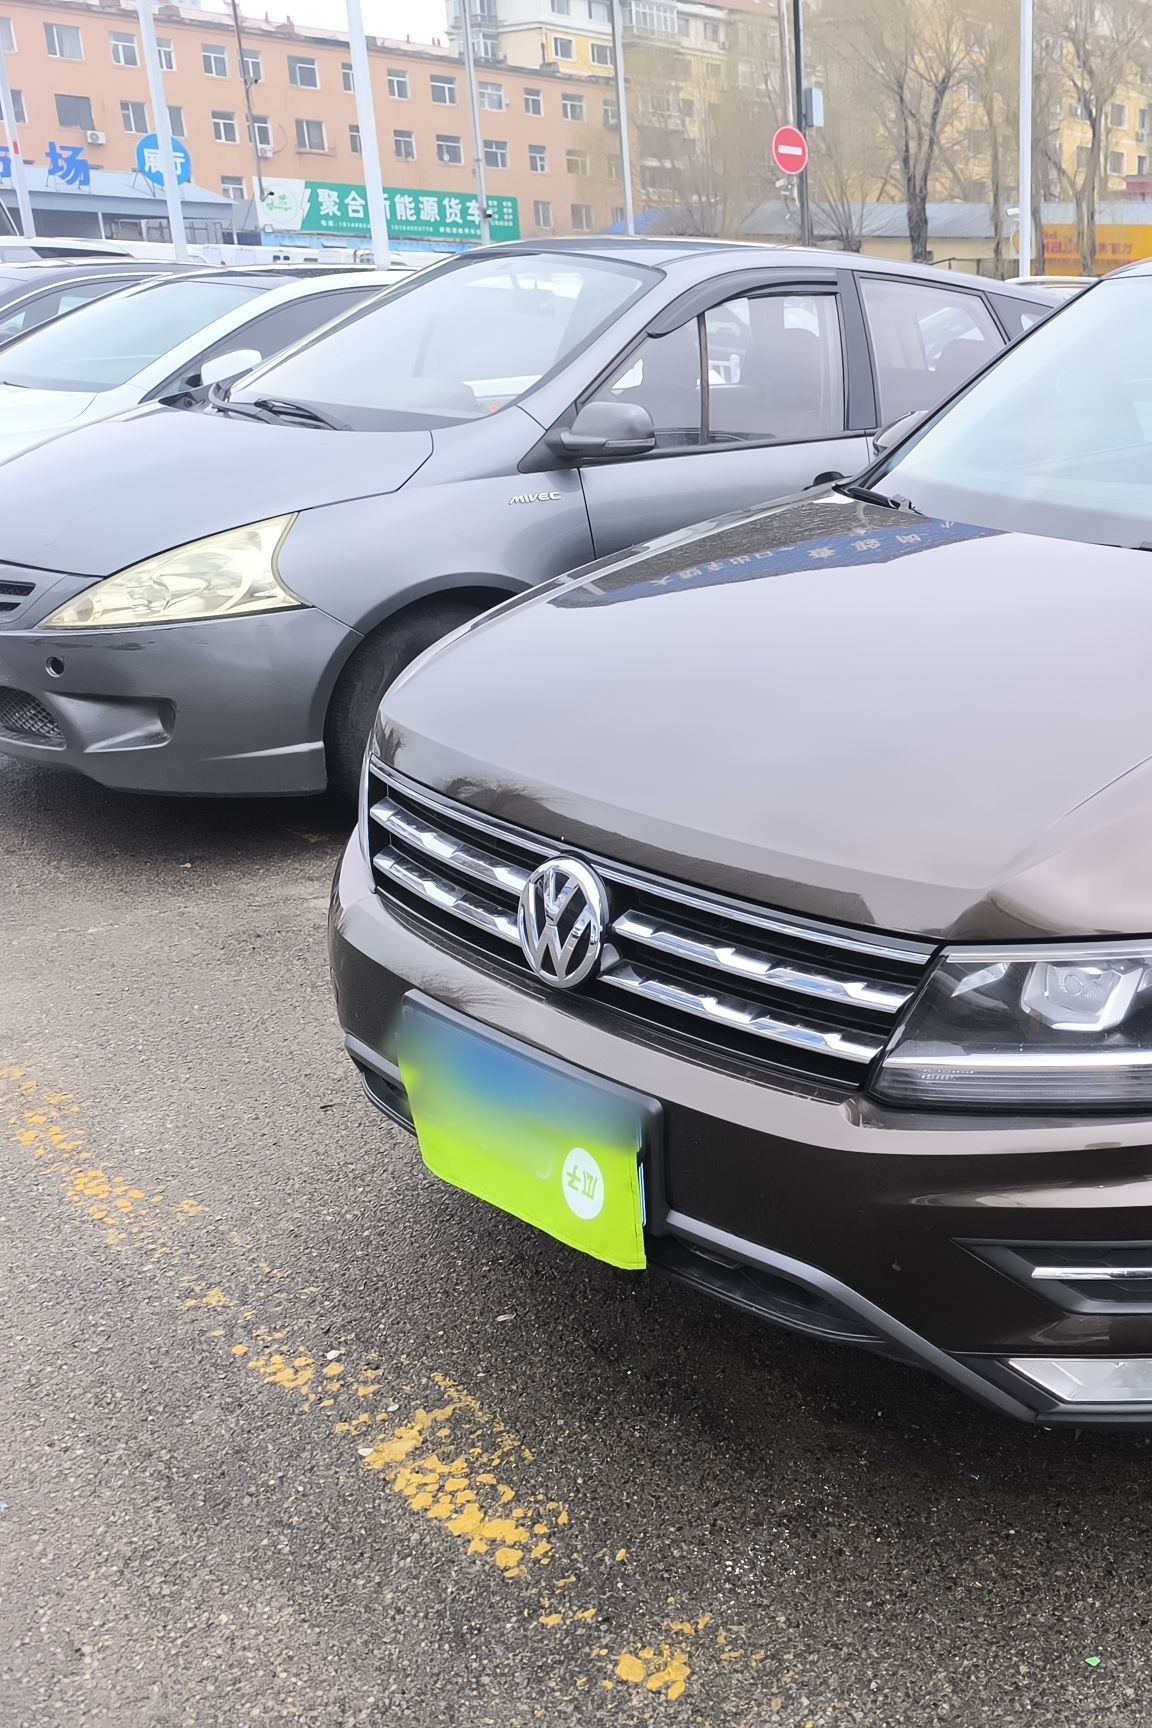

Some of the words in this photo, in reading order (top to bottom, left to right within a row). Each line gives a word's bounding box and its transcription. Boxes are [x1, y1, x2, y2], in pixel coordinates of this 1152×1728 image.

[509, 491, 562, 505] MIVEC
[521, 858, 603, 986] VW
[565, 1164, 598, 1201] 瓜子
